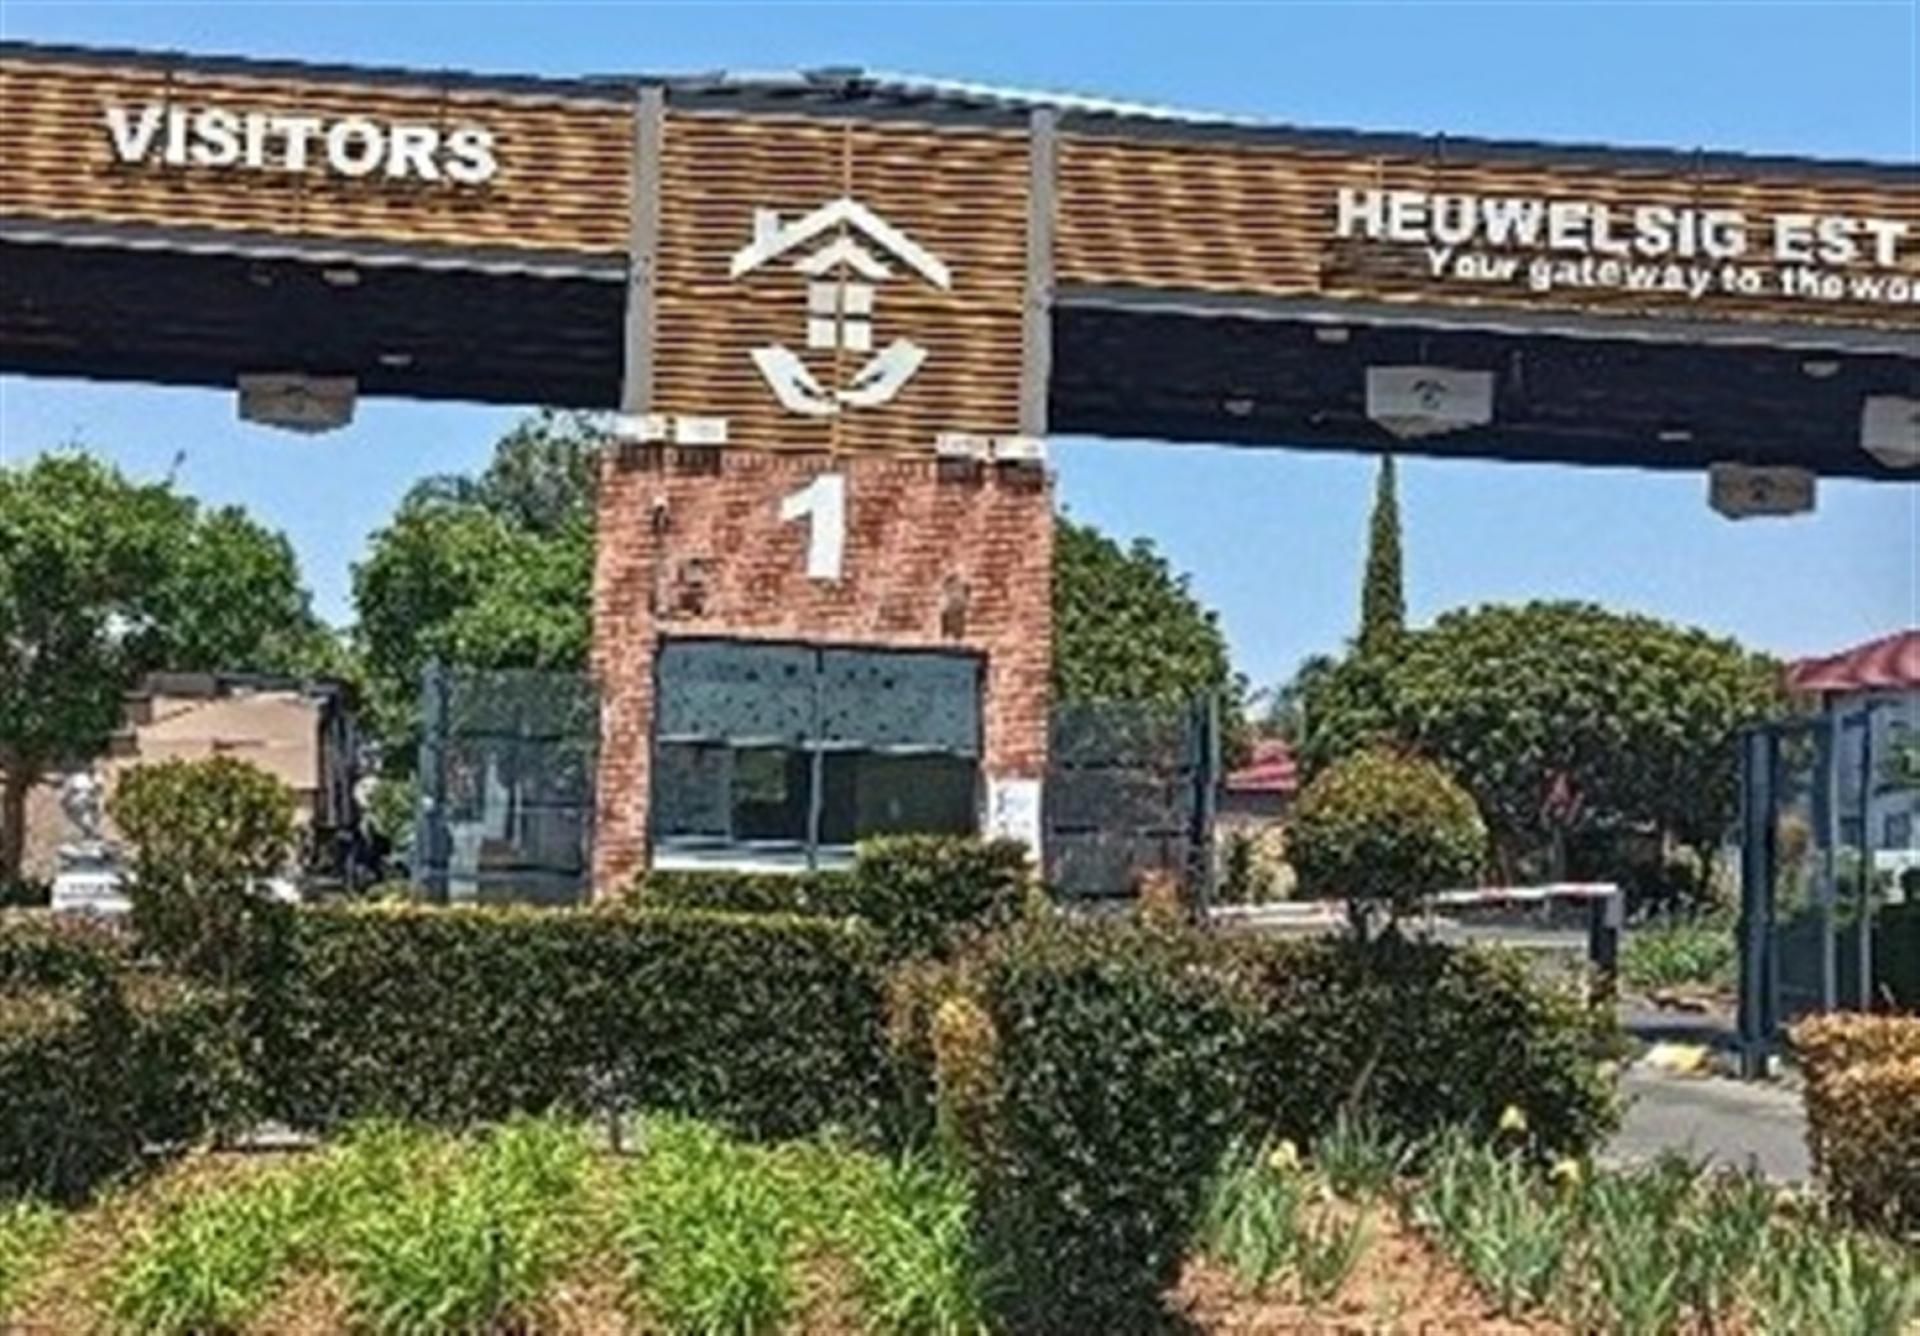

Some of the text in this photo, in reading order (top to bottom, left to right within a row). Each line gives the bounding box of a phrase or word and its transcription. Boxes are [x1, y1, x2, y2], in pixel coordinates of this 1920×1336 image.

[106, 106, 498, 184] VISITORS
[1336, 188, 1747, 260] HEUWELSIG
[1427, 248, 1517, 281] Your
[1529, 252, 1711, 299] gateway
[1721, 266, 1761, 293] to
[1782, 267, 1844, 299] the
[781, 474, 845, 578] 1
